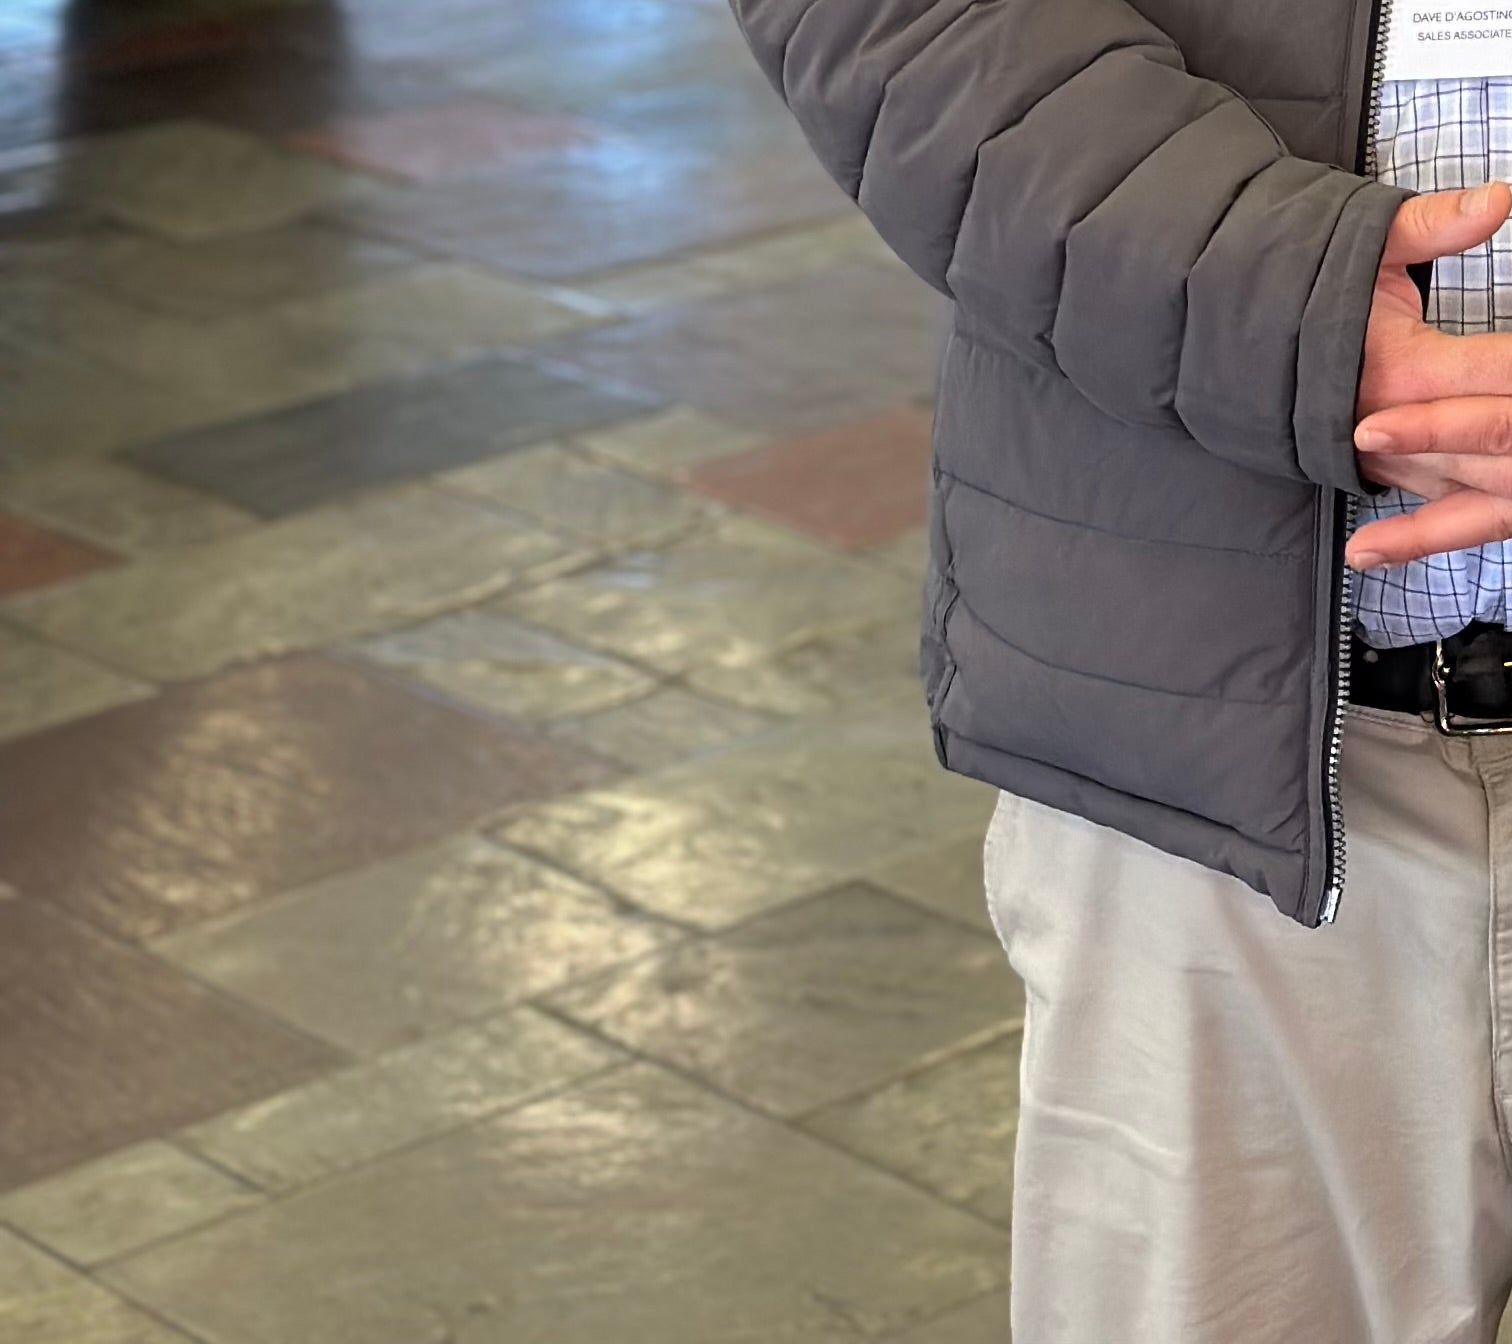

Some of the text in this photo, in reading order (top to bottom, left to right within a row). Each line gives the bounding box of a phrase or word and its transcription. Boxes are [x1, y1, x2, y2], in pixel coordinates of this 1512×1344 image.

[1413, 12, 1442, 23] DAVE
[1417, 29, 1512, 41] SALES ASSOCIATE
